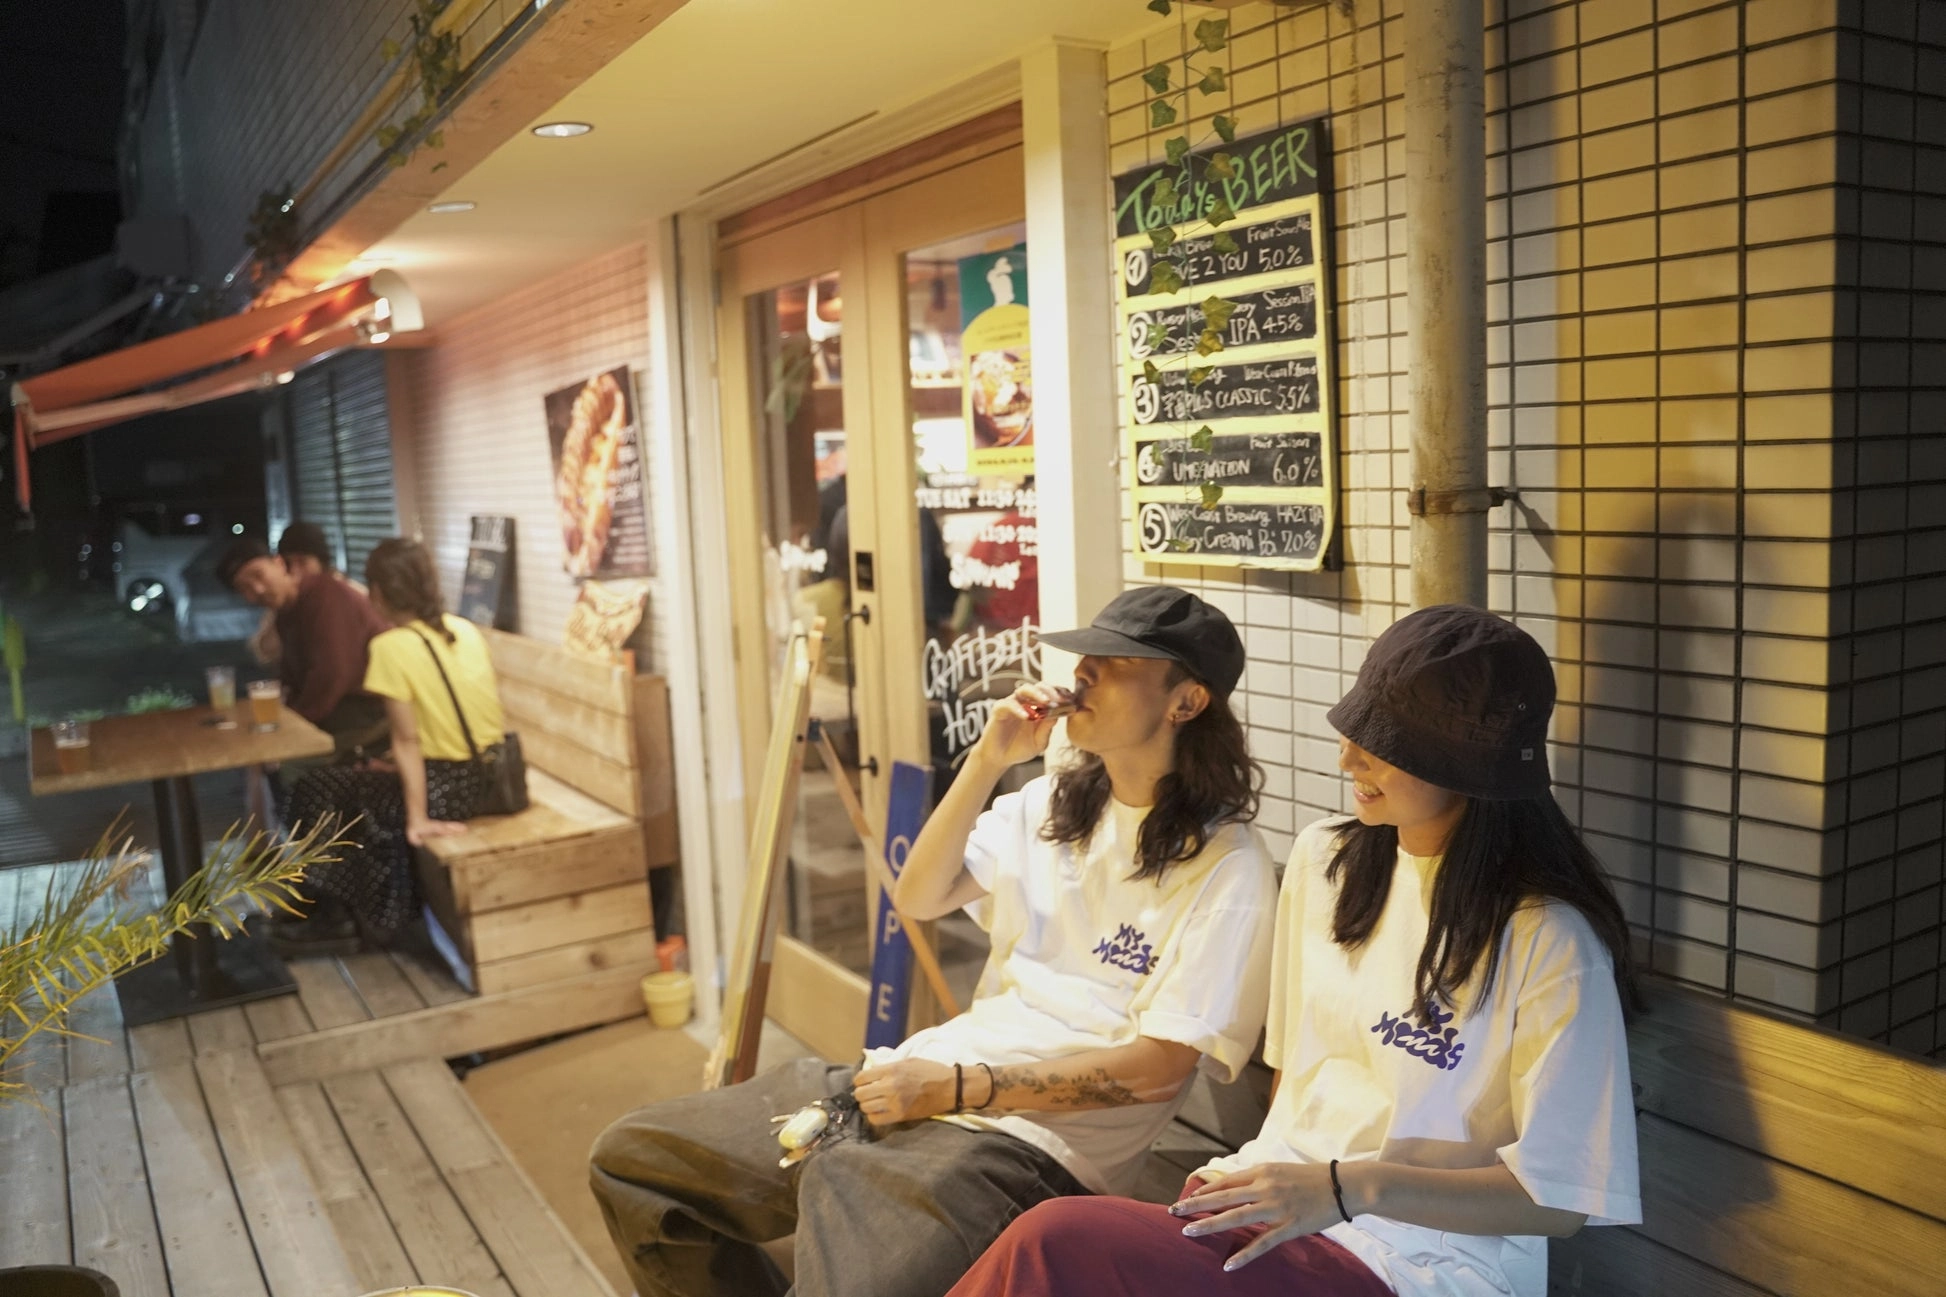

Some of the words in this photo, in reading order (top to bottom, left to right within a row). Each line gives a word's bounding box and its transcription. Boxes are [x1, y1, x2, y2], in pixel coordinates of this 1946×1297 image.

[1222, 127, 1317, 213] BEER
[1247, 226, 1275, 244] Fruit
[1201, 255, 1217, 276] 2
[1218, 251, 1249, 274] YOU
[1258, 245, 1304, 273] 5.0%
[1262, 291, 1301, 310] Session
[1229, 318, 1261, 345] IPA
[1262, 313, 1304, 334] 4.5%
[1215, 387, 1273, 409] CLASSIC
[1275, 384, 1311, 411] 5.5%
[1224, 505, 1272, 528] Brewing
[1281, 529, 1318, 553] 7.0%
